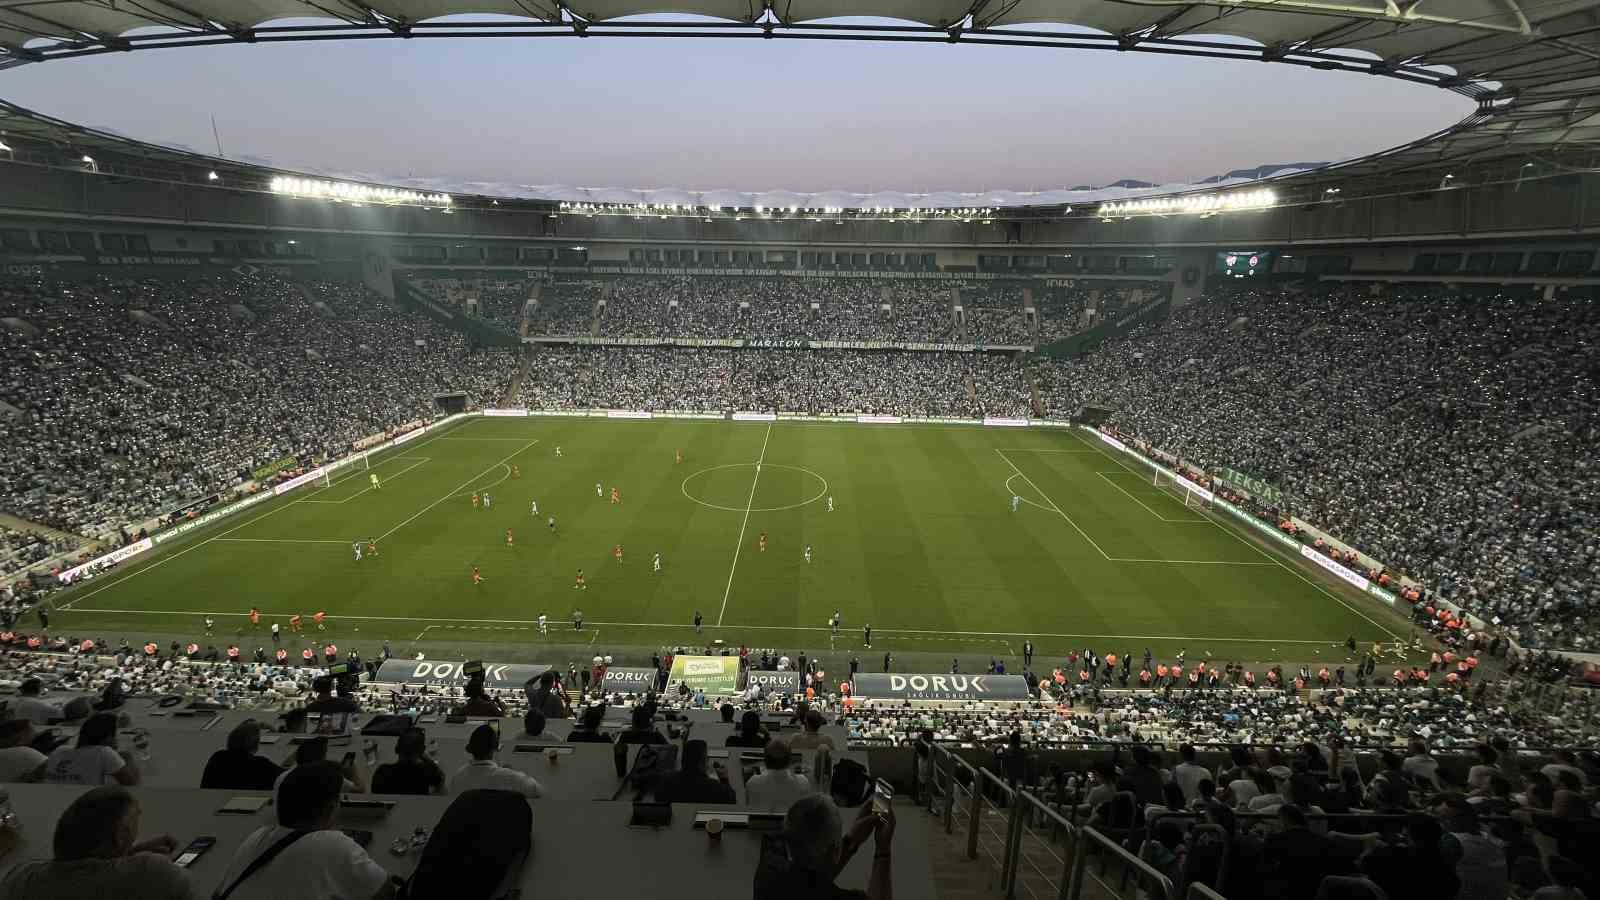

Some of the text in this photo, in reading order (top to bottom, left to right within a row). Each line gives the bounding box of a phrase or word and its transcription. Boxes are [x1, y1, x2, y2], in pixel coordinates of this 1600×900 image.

[605, 671, 650, 681] DORUK
[750, 675, 793, 685] DORUK
[890, 675, 990, 692] DORUK
